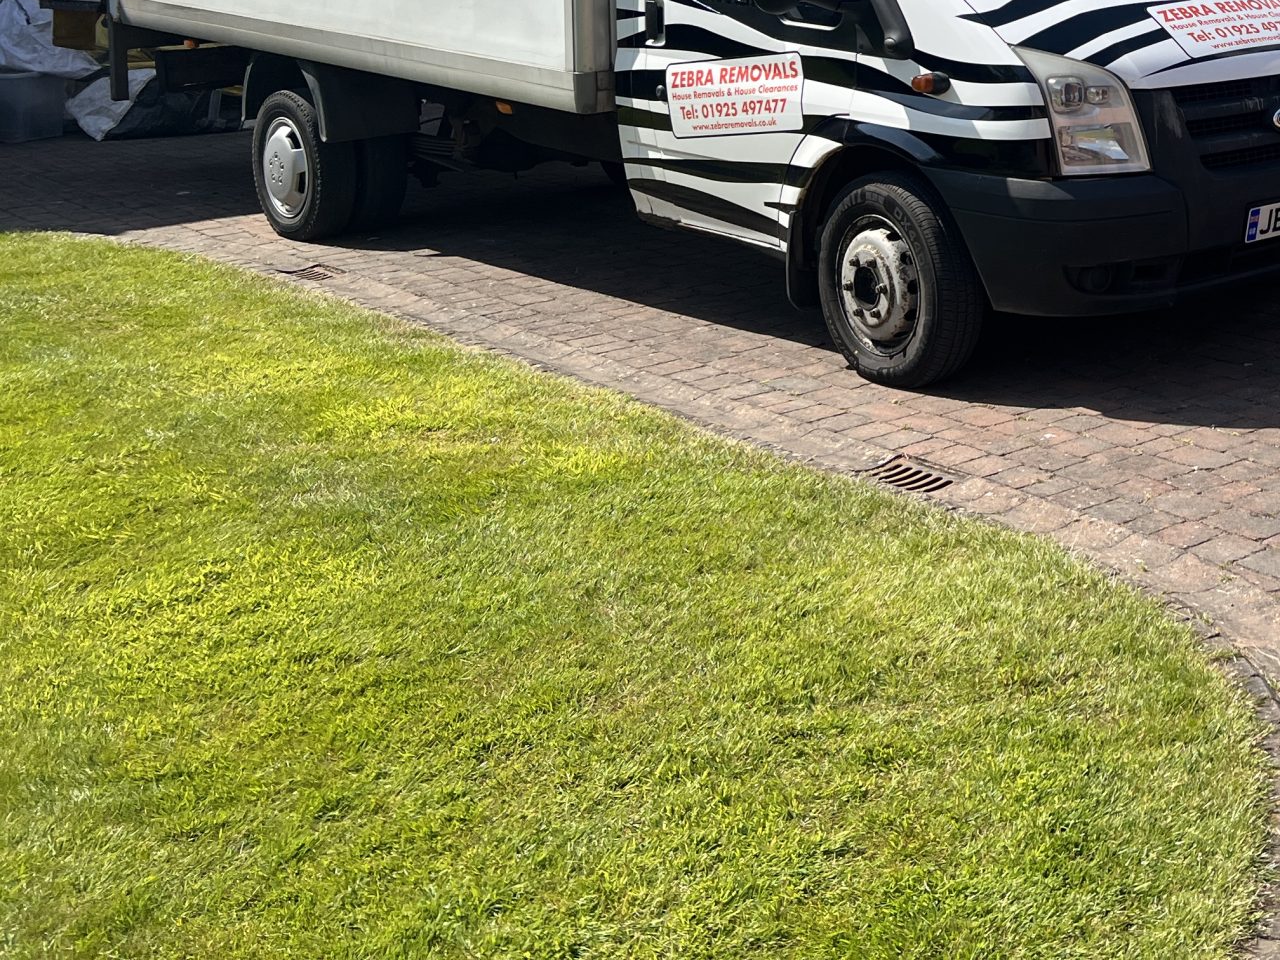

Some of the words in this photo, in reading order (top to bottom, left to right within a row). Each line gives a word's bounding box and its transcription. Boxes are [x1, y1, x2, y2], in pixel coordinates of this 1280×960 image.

[1156, 4, 1217, 22] ZEBRA
[1169, 22, 1197, 30] House
[1197, 15, 1236, 26] Removals
[1187, 29, 1216, 43] Tel:
[1214, 24, 1260, 38] 01925
[671, 68, 714, 89] ZEBRA
[720, 61, 798, 84] REMOVALS
[672, 92, 692, 101] House
[694, 88, 725, 100] Removals
[727, 87, 732, 96] &
[735, 86, 756, 96] House
[758, 84, 798, 94] Clearances
[680, 104, 699, 120] Tel:
[702, 102, 738, 119] 01925
[742, 98, 787, 117] 497477
[692, 117, 777, 131] www.zebraremovals.co.uk
